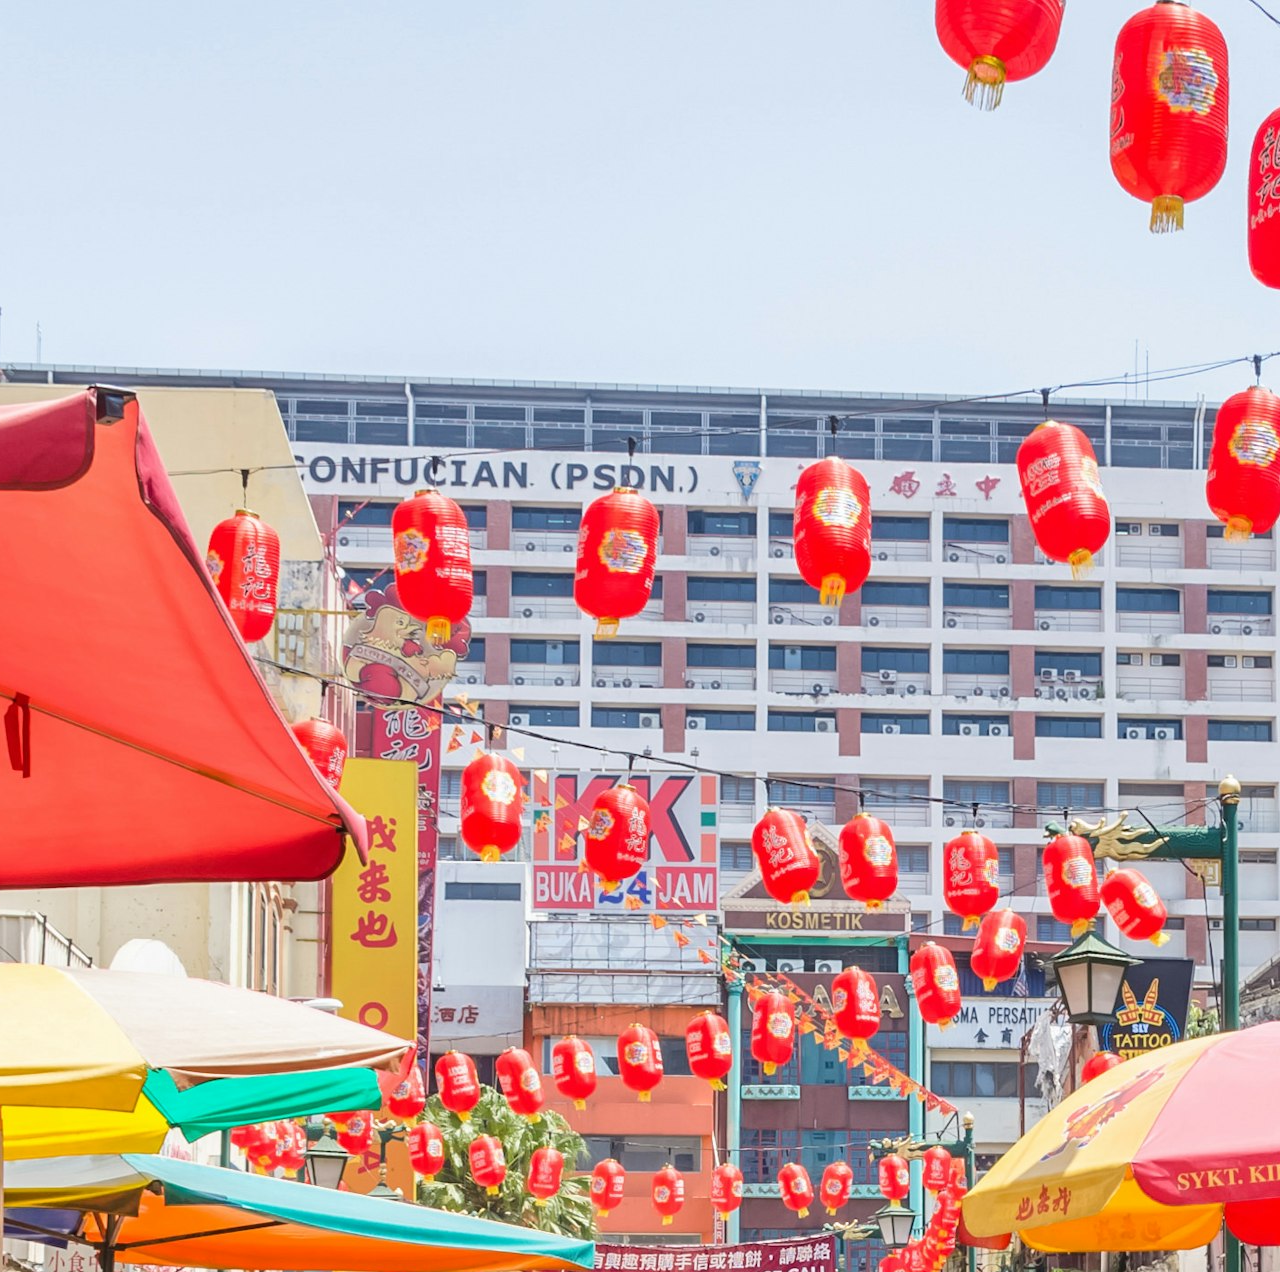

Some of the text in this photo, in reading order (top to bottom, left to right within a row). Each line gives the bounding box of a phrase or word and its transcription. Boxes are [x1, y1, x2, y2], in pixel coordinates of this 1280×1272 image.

[535, 870, 593, 904] BUKA
[659, 872, 713, 904] JAM
[766, 912, 864, 930] KOSMETIK
[1131, 1023, 1149, 1033] SLY
[1113, 1033, 1171, 1048] TATTOO
[1176, 1168, 1244, 1192] SYKT.
